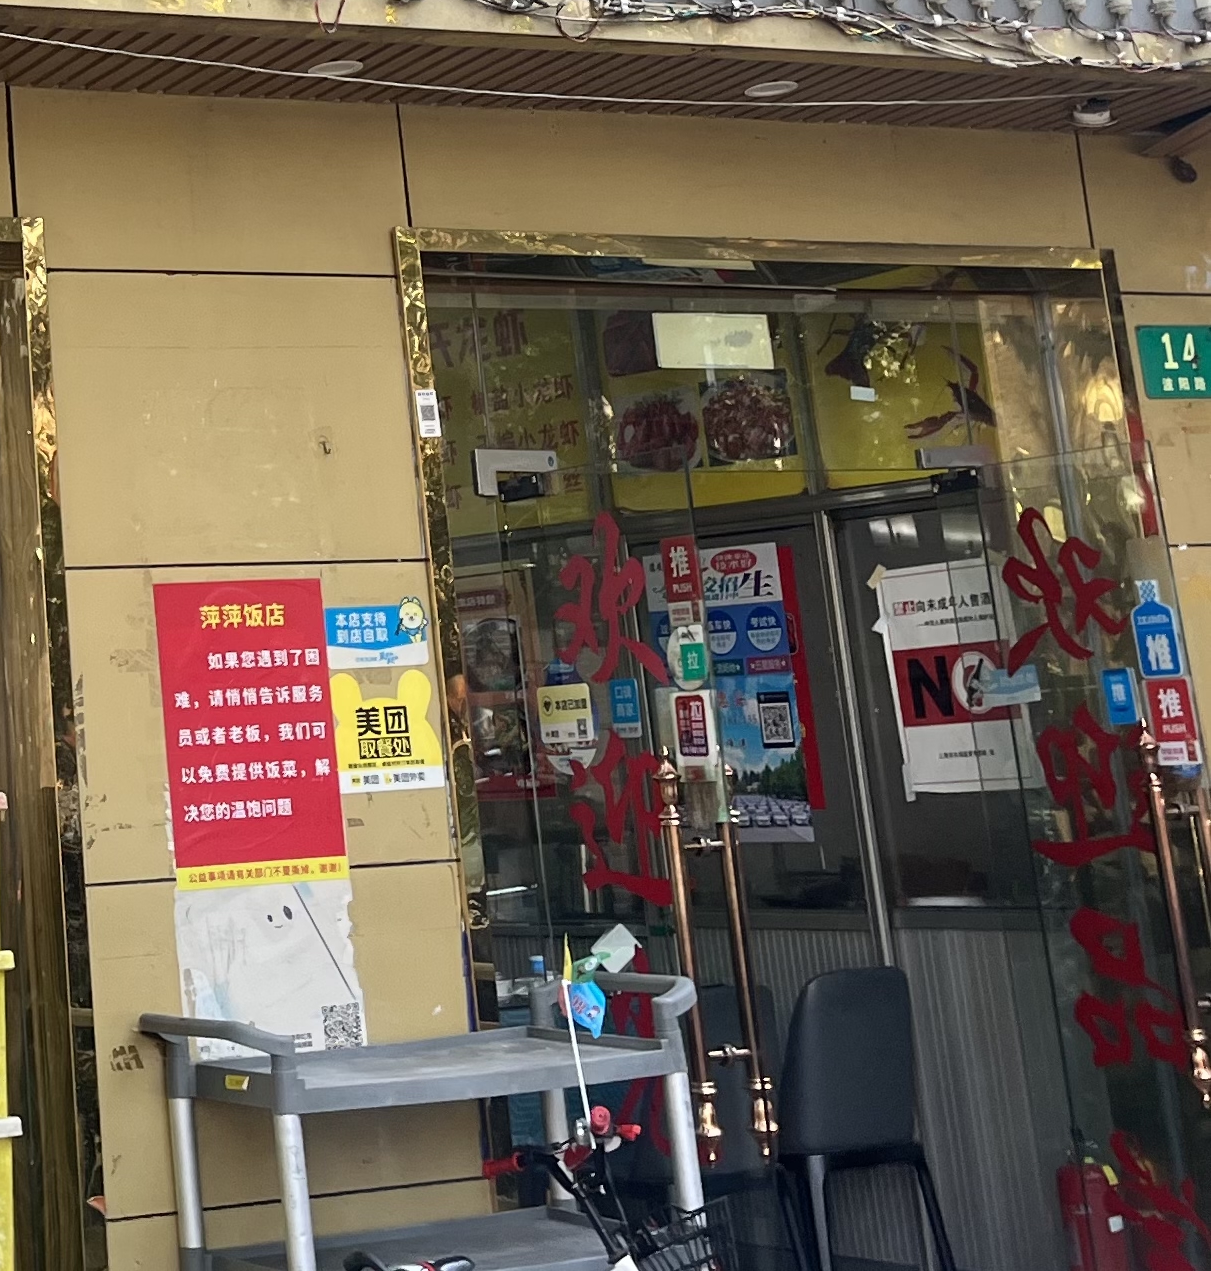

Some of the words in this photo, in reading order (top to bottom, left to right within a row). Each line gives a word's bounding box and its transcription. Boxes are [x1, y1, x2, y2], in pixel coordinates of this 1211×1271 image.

[669, 545, 691, 578] 推
[199, 603, 286, 629] 萍萍饭店
[335, 612, 387, 628] 本店支持
[207, 648, 321, 671] 如果您遇到了困
[687, 652, 701, 671] 拉
[1145, 633, 1175, 671] 推
[174, 684, 324, 710] 难，请悄悄告诉服务
[1157, 688, 1184, 719] 推
[355, 705, 410, 737] 美团
[177, 721, 327, 748] 员或者老板，我们可
[360, 738, 411, 759] 取餐处
[180, 758, 331, 784] 以免费提供饭菜，解
[183, 797, 293, 823] 决您的温饱问题
